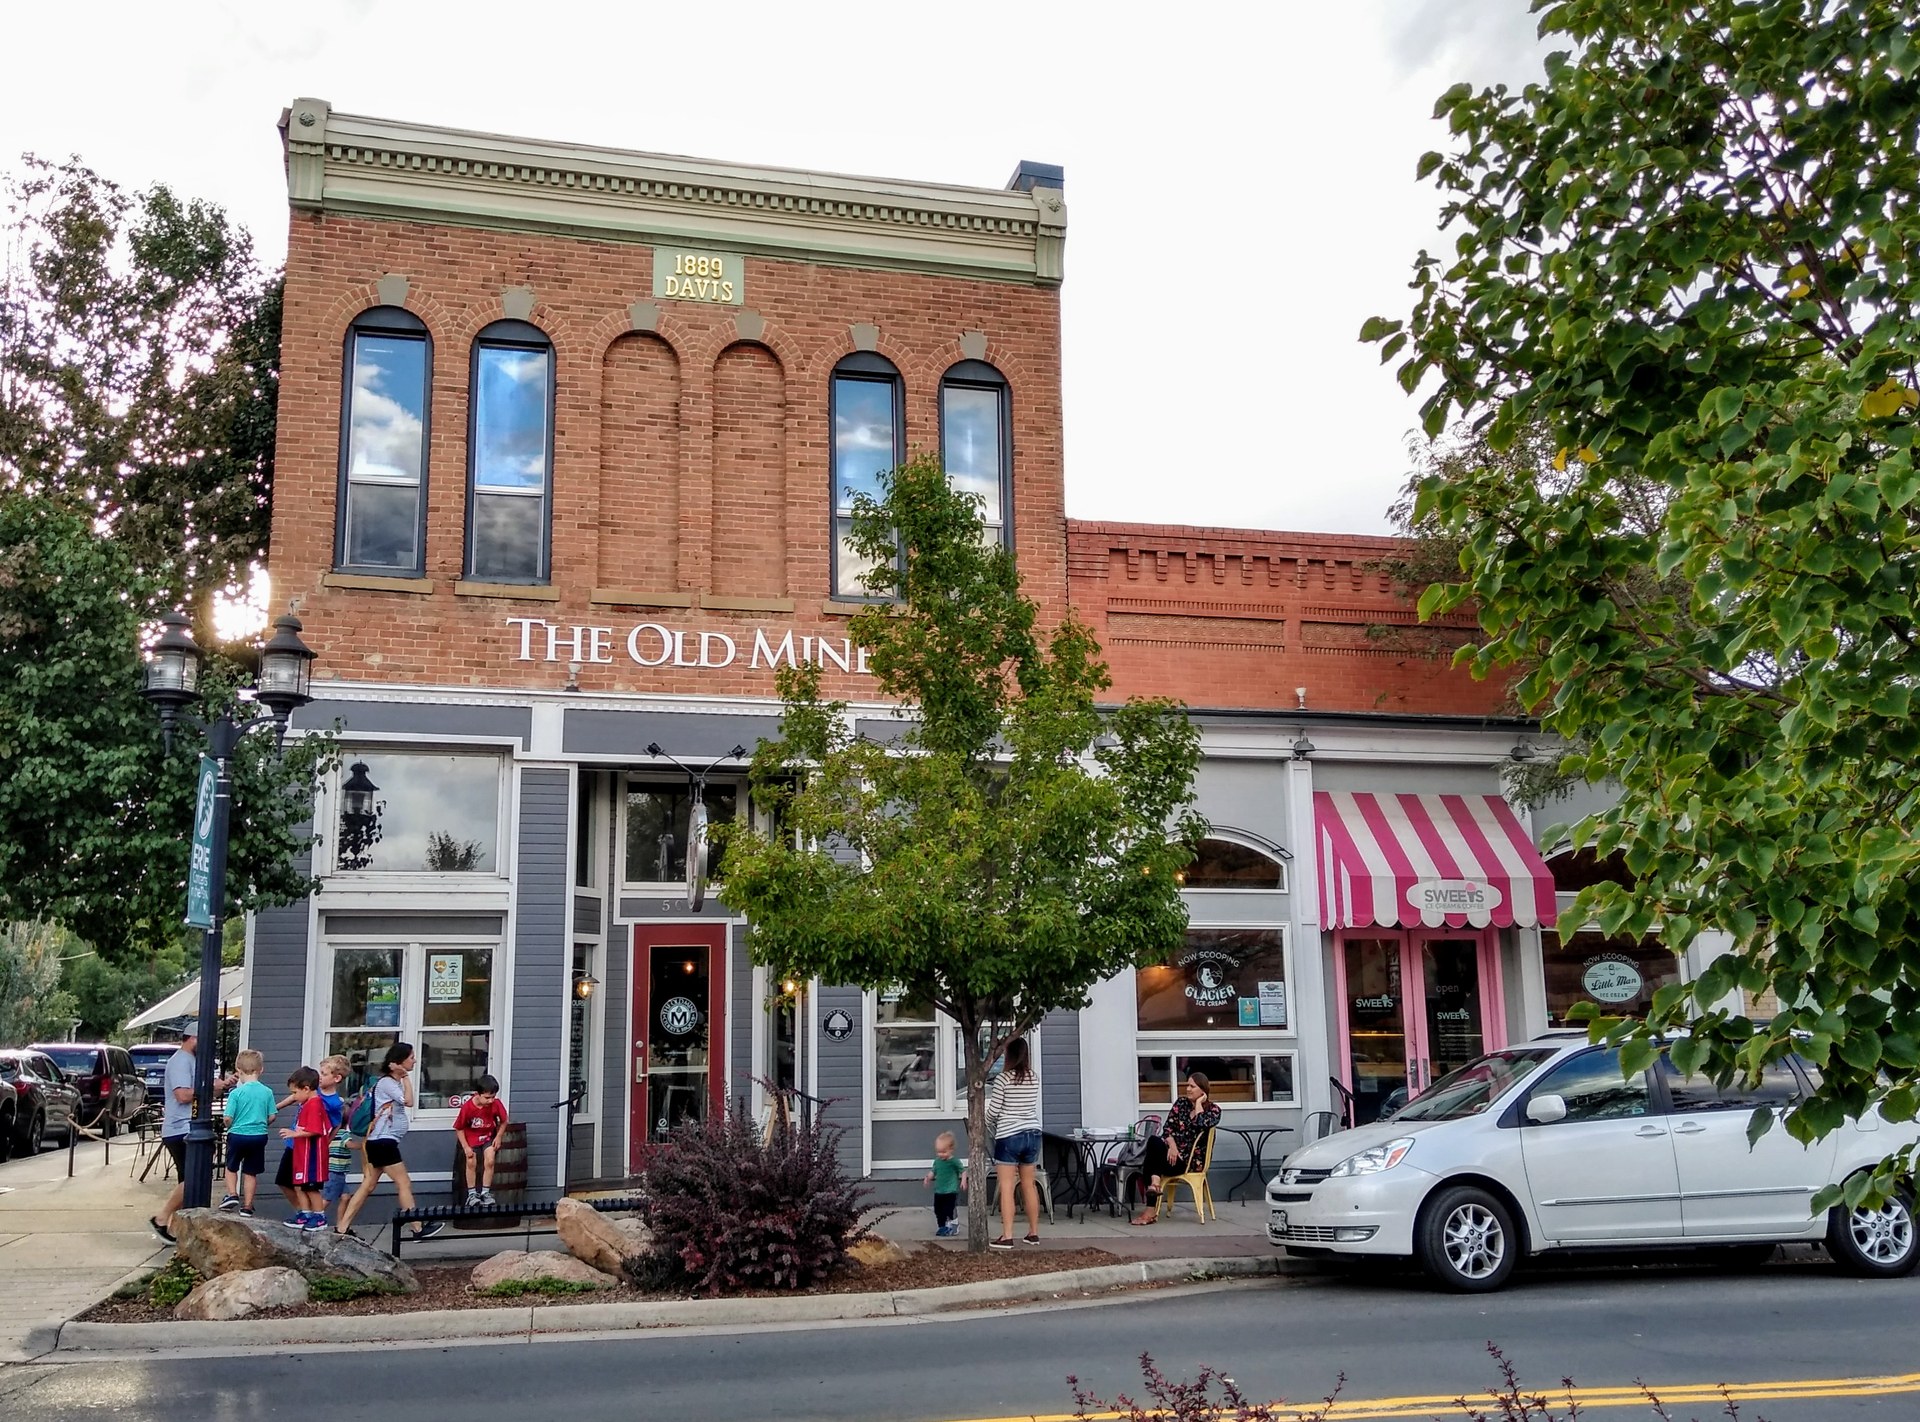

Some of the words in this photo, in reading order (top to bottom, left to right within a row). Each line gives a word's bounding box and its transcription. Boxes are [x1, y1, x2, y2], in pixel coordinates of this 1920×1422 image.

[675, 254, 723, 278] 1889
[665, 275, 733, 302] DAVIS
[506, 617, 613, 664] THE
[627, 623, 736, 668] OLD
[1424, 882, 1485, 903] SWEETS
[1178, 952, 1197, 966] NOW
[1199, 951, 1240, 967] SCOOPING
[1583, 955, 1600, 967] NOW
[1602, 953, 1640, 968] SCOOPING
[1436, 984, 1459, 995] open
[1591, 979, 1615, 990] Little
[1617, 976, 1636, 986] Man
[1185, 984, 1236, 1001] GLACIER
[1356, 994, 1393, 1008] SWEETS
[1437, 1008, 1470, 1020] SWEETS
